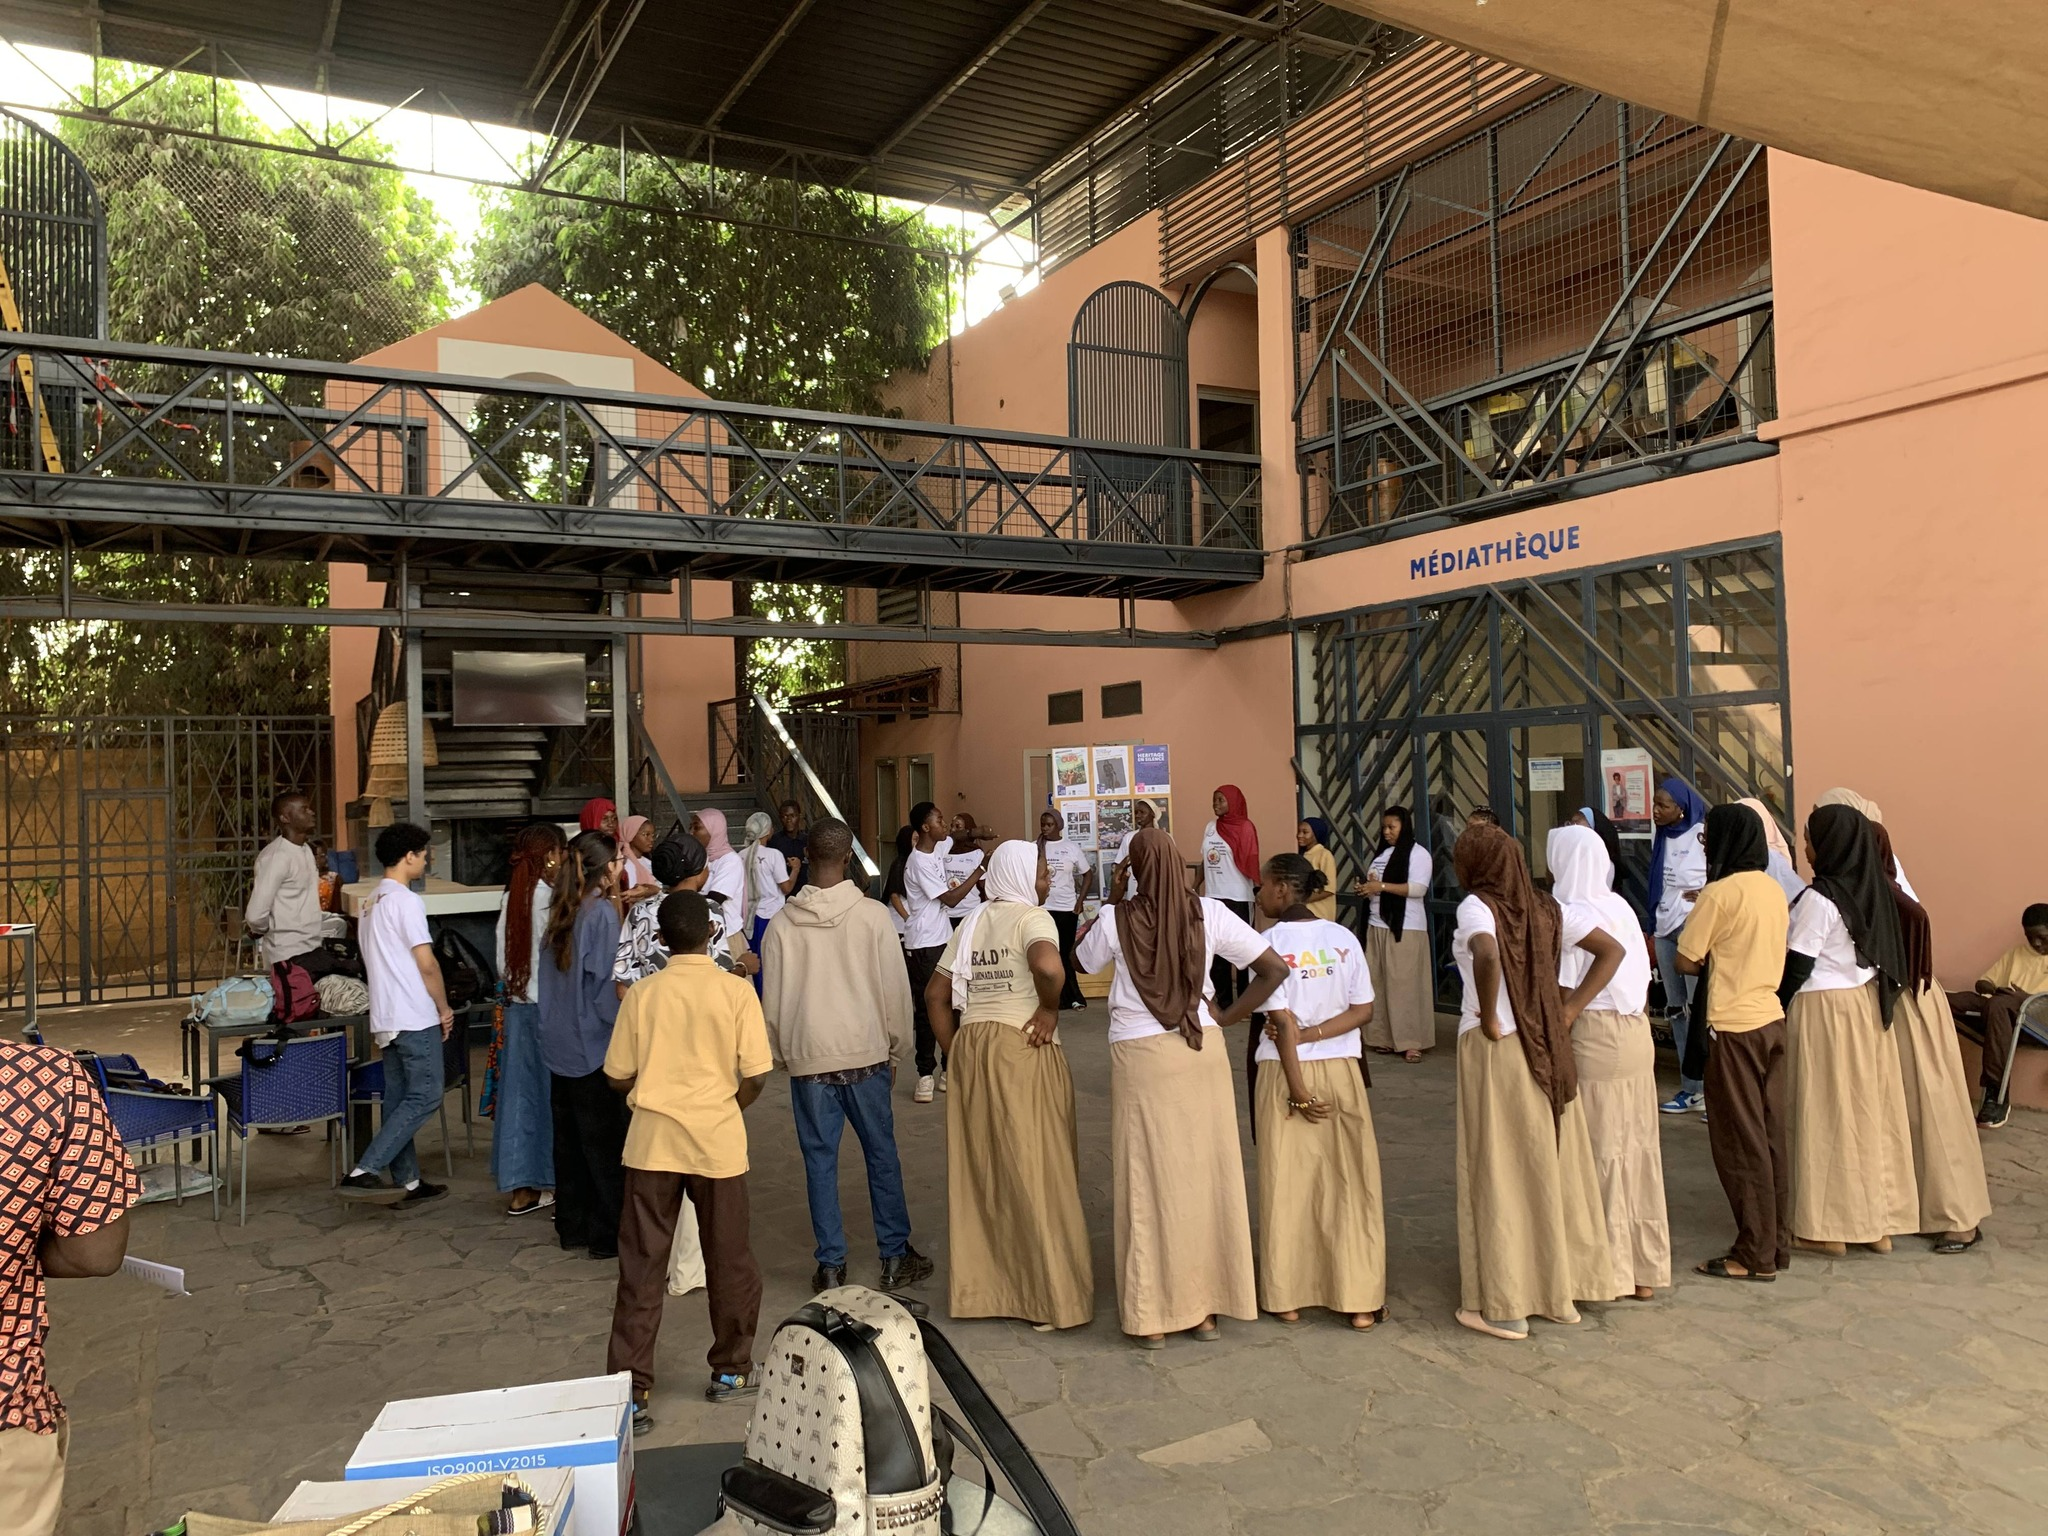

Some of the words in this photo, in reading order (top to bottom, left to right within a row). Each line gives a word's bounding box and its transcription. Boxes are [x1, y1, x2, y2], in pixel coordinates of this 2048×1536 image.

[1410, 525, 1580, 580] MÉDIATHÈQUE
[1280, 947, 1350, 969] RALY
[994, 969, 1014, 979] DIALLO
[1300, 966, 1334, 979] 2026
[427, 1453, 547, 1477] ISO9001-V2015
